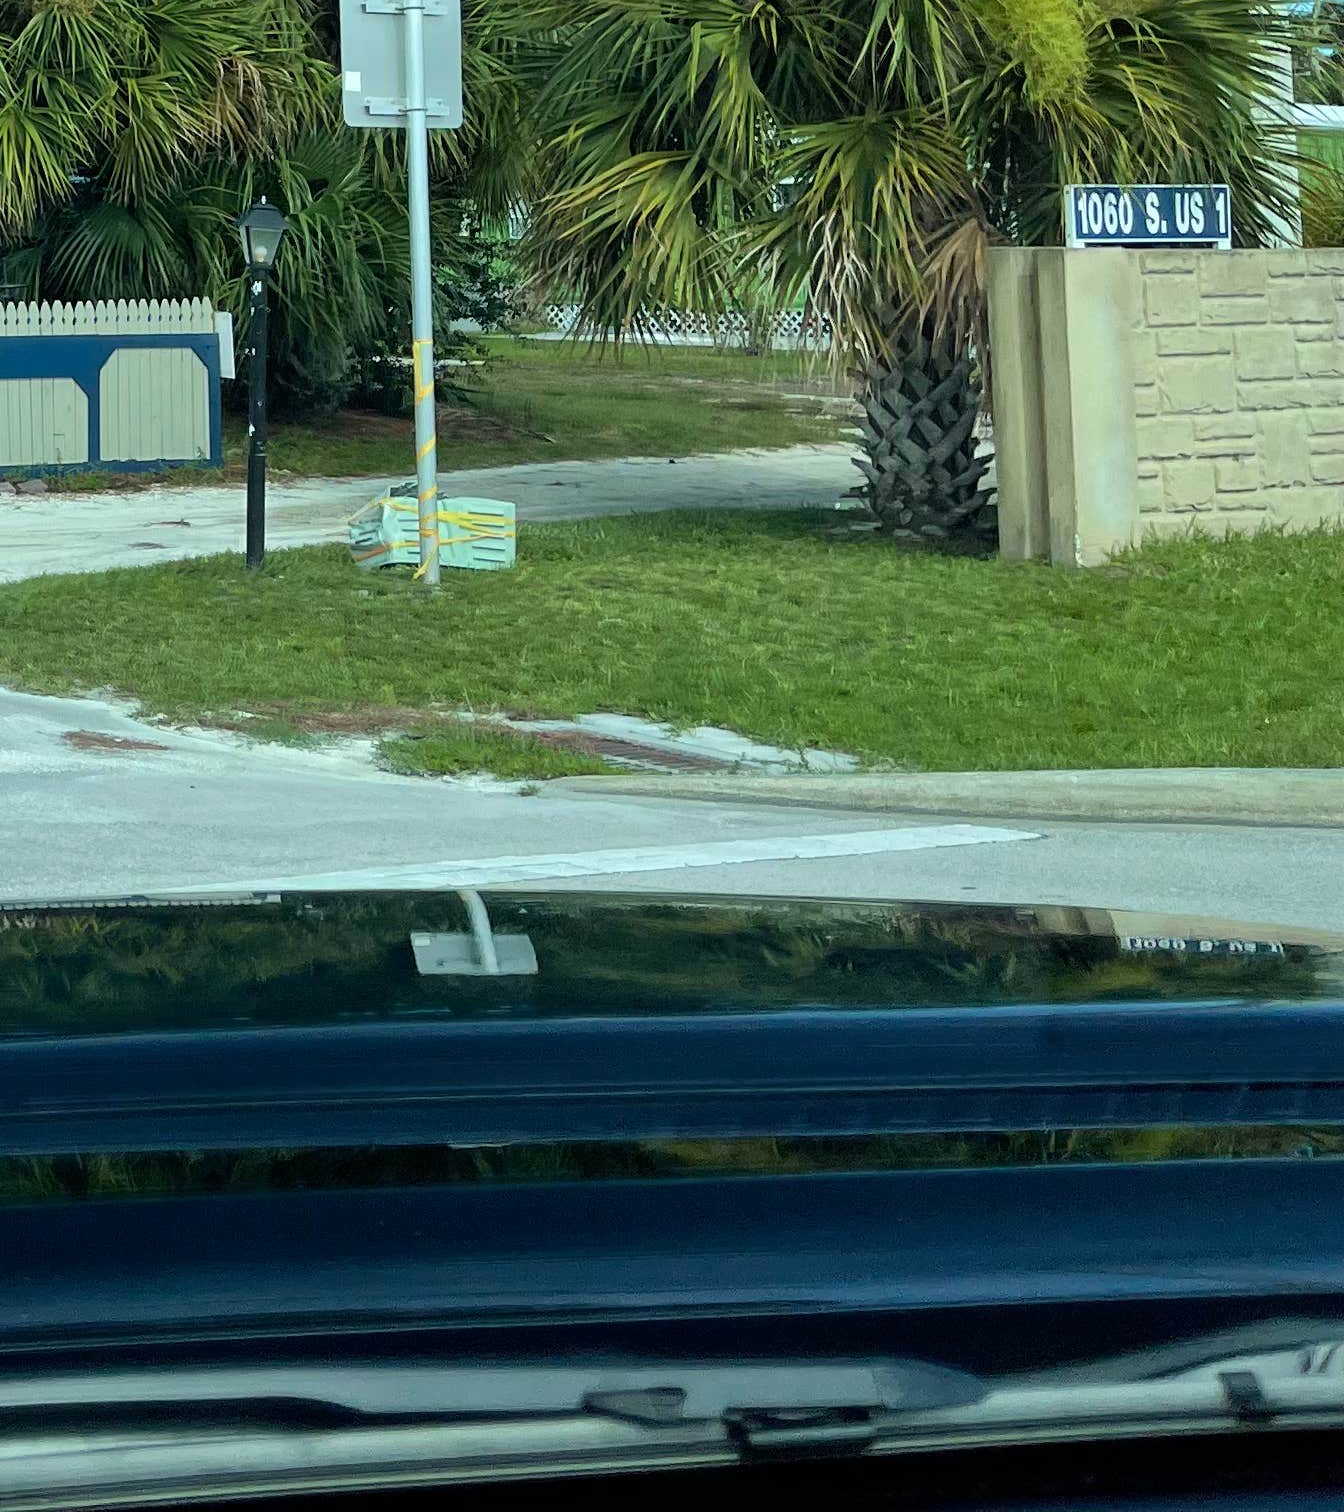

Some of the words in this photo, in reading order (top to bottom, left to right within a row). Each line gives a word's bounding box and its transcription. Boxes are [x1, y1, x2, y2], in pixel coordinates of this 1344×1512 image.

[1077, 192, 1133, 235] 1060
[1145, 191, 1168, 235] S.
[1175, 191, 1205, 235] US
[1215, 192, 1226, 233] 1
